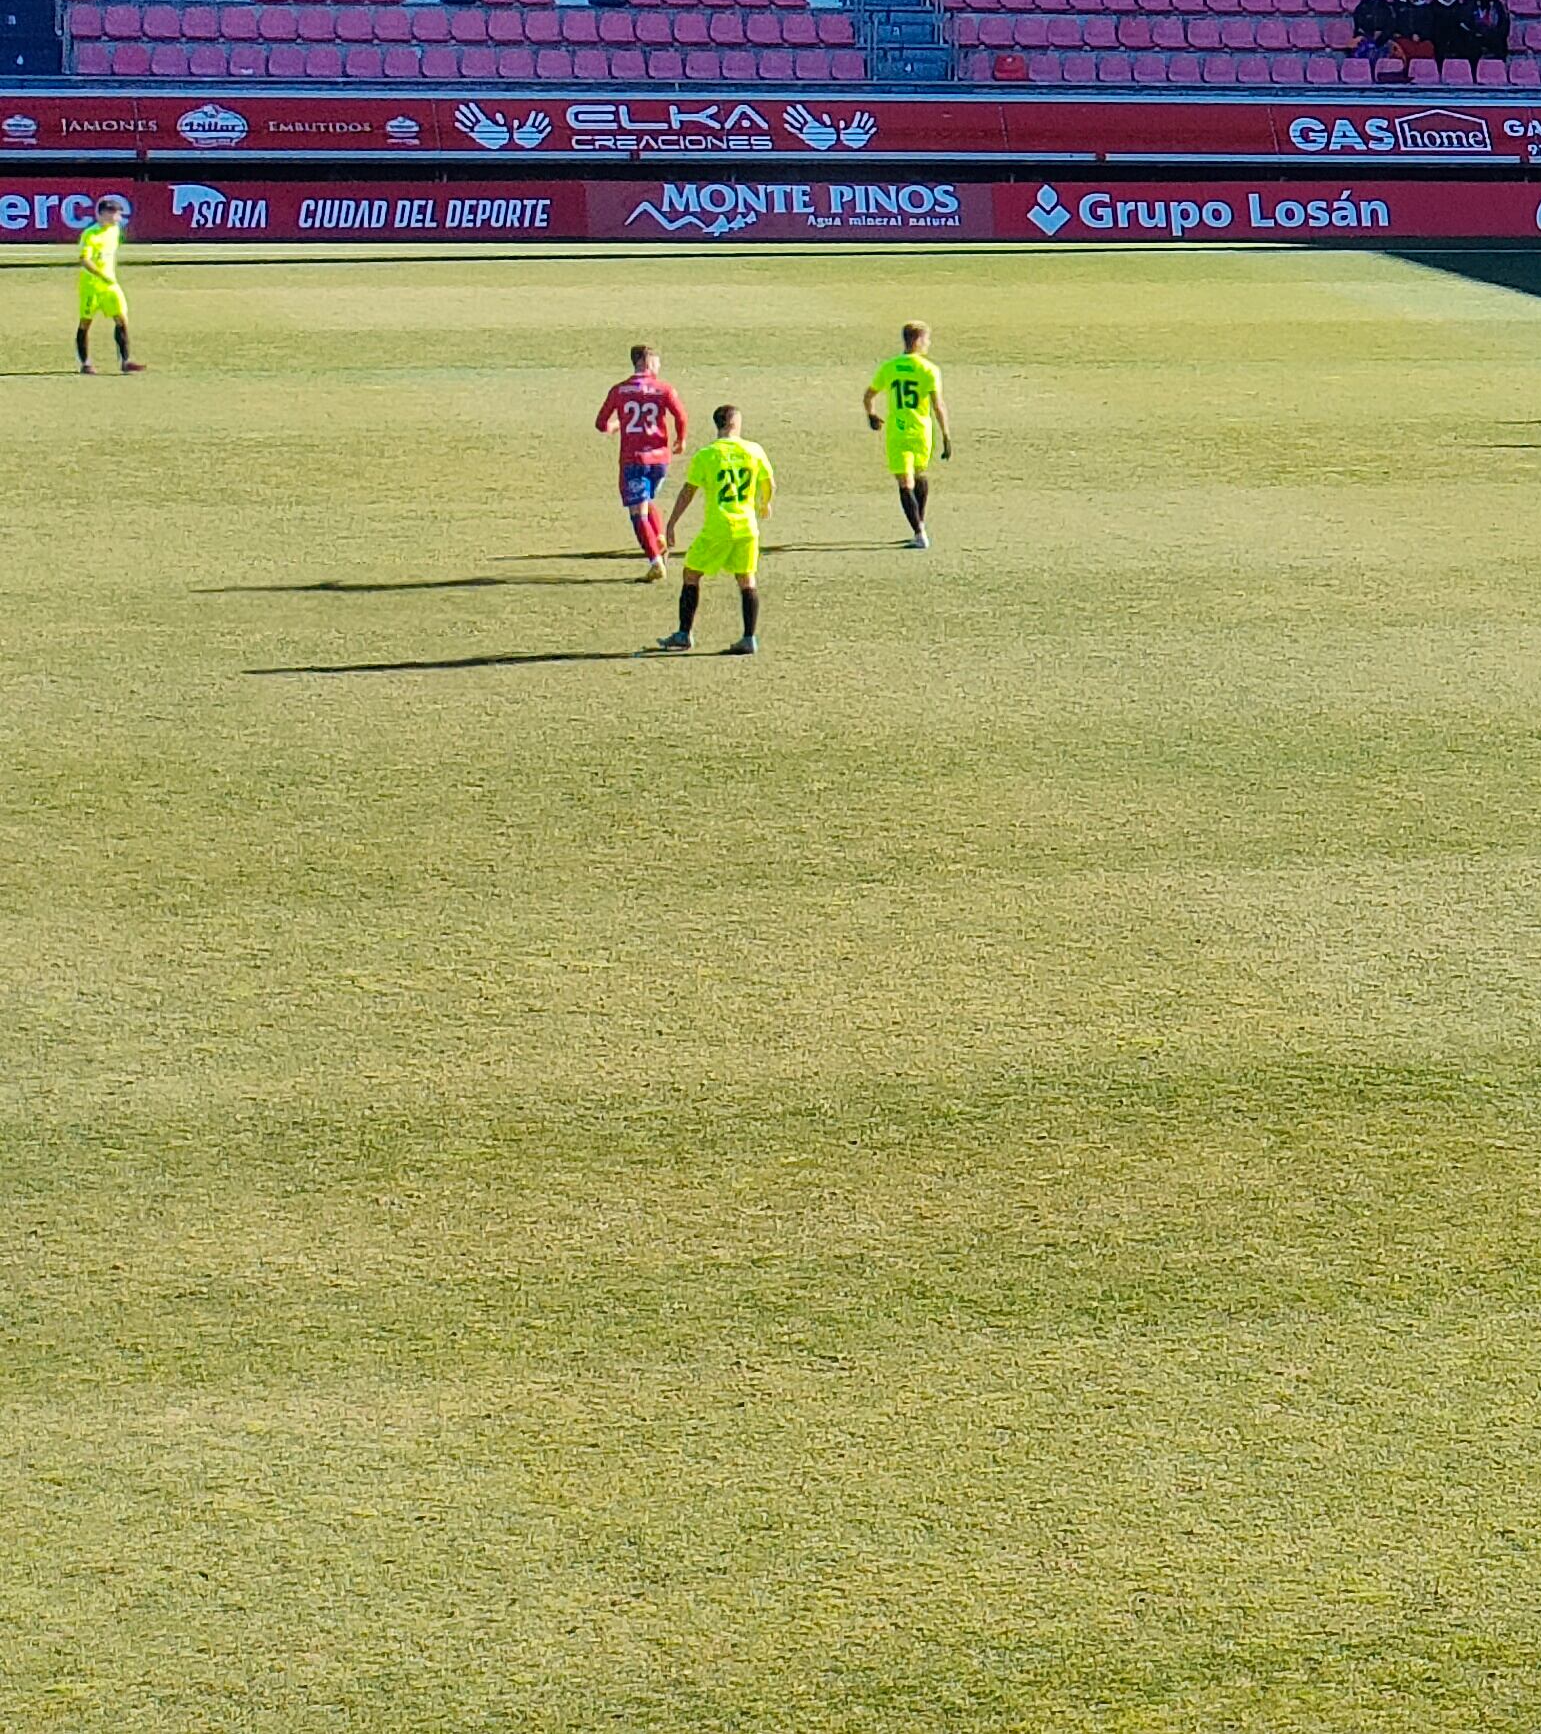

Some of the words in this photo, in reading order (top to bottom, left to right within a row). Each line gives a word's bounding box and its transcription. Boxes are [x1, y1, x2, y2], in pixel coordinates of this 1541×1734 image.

[61, 118, 158, 136] JAMONES
[268, 121, 372, 133] EMBUTIDOS
[566, 104, 769, 131] ELKA
[572, 136, 773, 150] CREACIONES
[1290, 118, 1394, 151] GAS
[1402, 122, 1485, 150] home
[299, 198, 386, 229] CIUDAD
[395, 198, 438, 228] DEL
[447, 198, 551, 228] DEPORTE
[659, 183, 816, 214] MONTE
[829, 183, 960, 215] PINOS
[1078, 192, 1232, 237] Grupo
[1248, 189, 1390, 229] Losán
[807, 215, 842, 228] Agua
[848, 214, 903, 227] mineral
[908, 214, 961, 227] natural
[890, 379, 919, 410] 15
[624, 400, 659, 434] 23
[716, 468, 752, 504] 22
